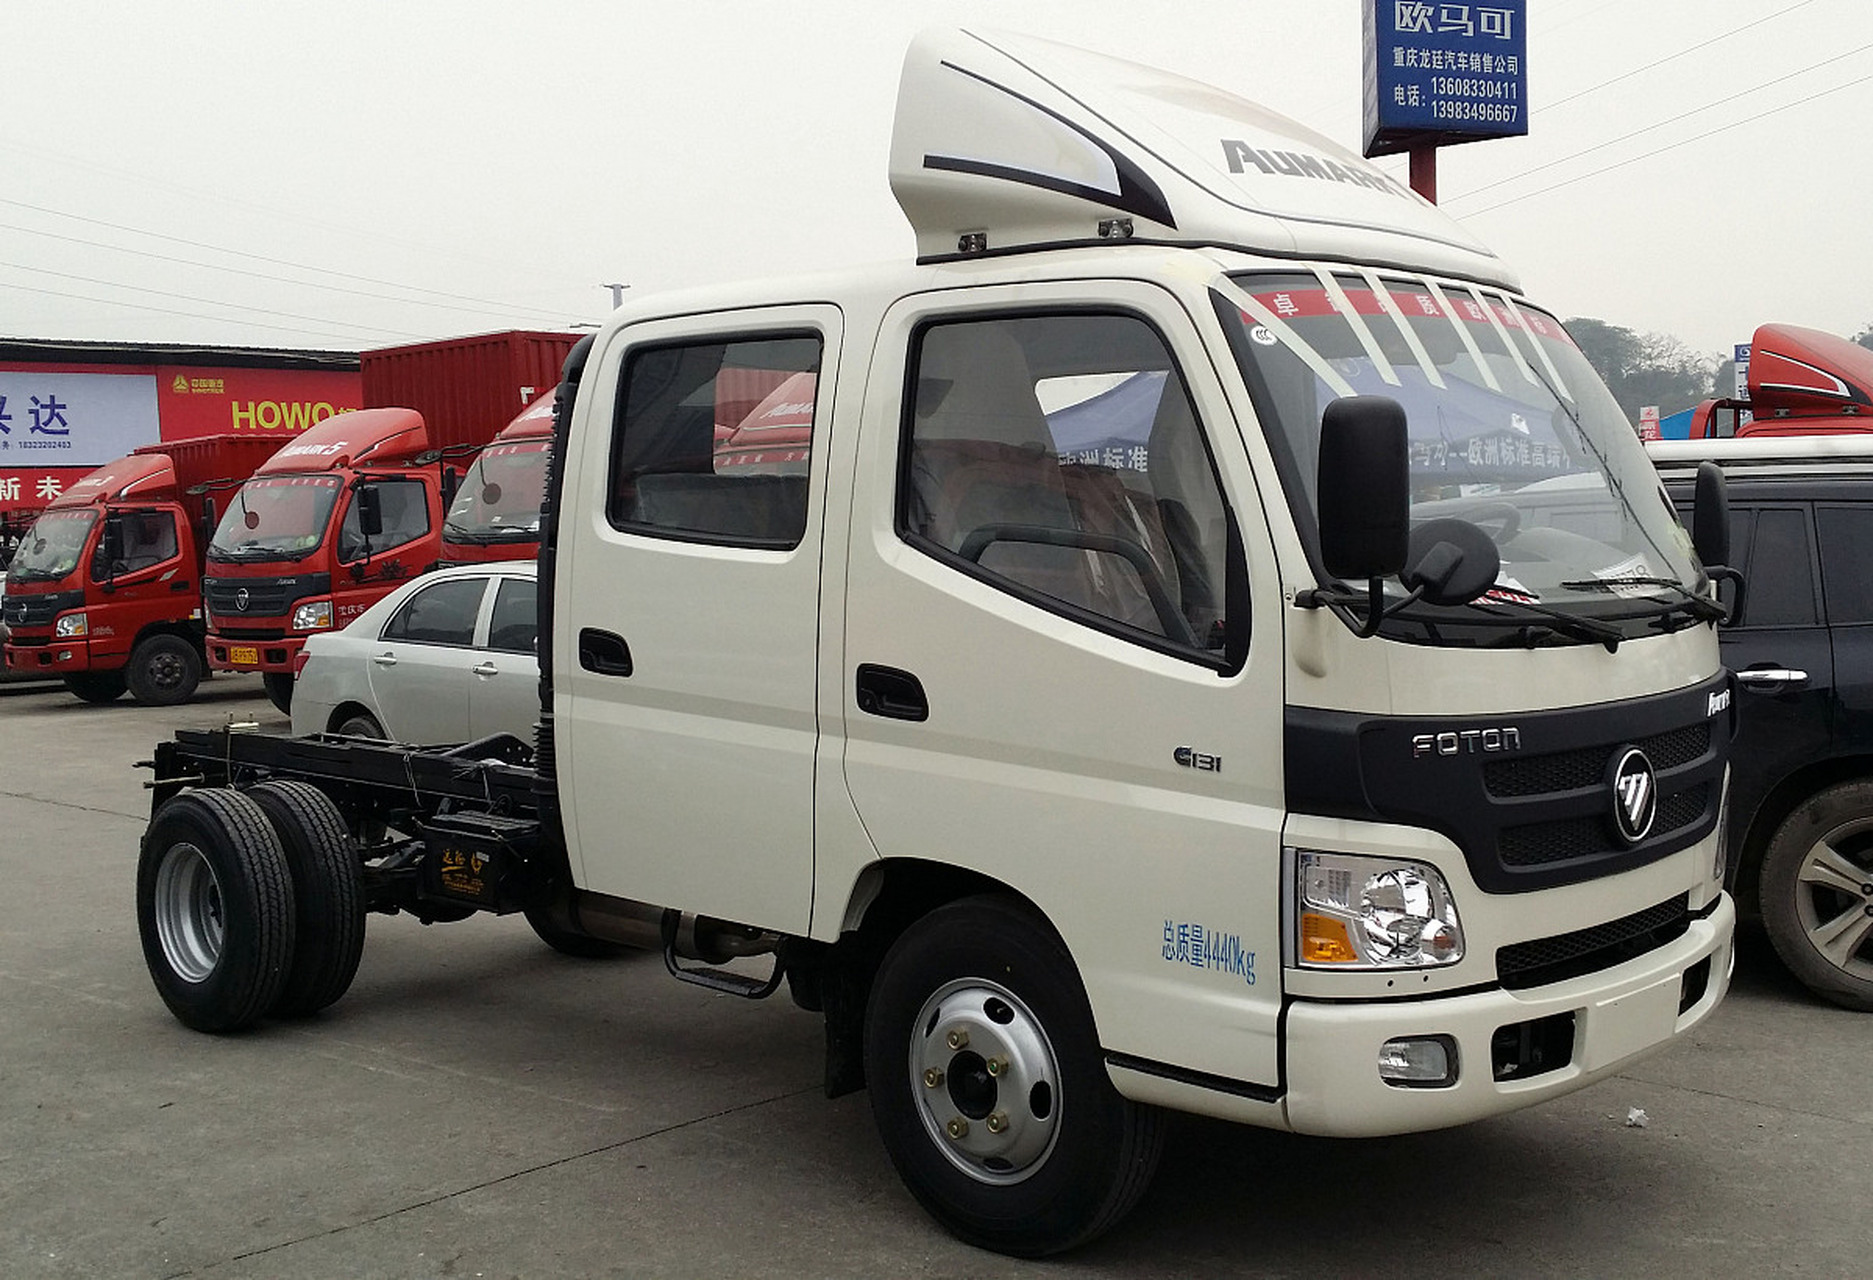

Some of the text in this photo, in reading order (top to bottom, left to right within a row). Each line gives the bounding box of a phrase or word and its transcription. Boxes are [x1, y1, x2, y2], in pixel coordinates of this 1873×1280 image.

[1394, 1, 1516, 40] 欧马可
[1392, 46, 1519, 76] 重庆龙廷汽车销售公司
[1431, 76, 1518, 100] 13608330411
[1431, 99, 1518, 123] 13983496667
[231, 400, 335, 430] HOWO
[1411, 726, 1521, 758] FOTON
